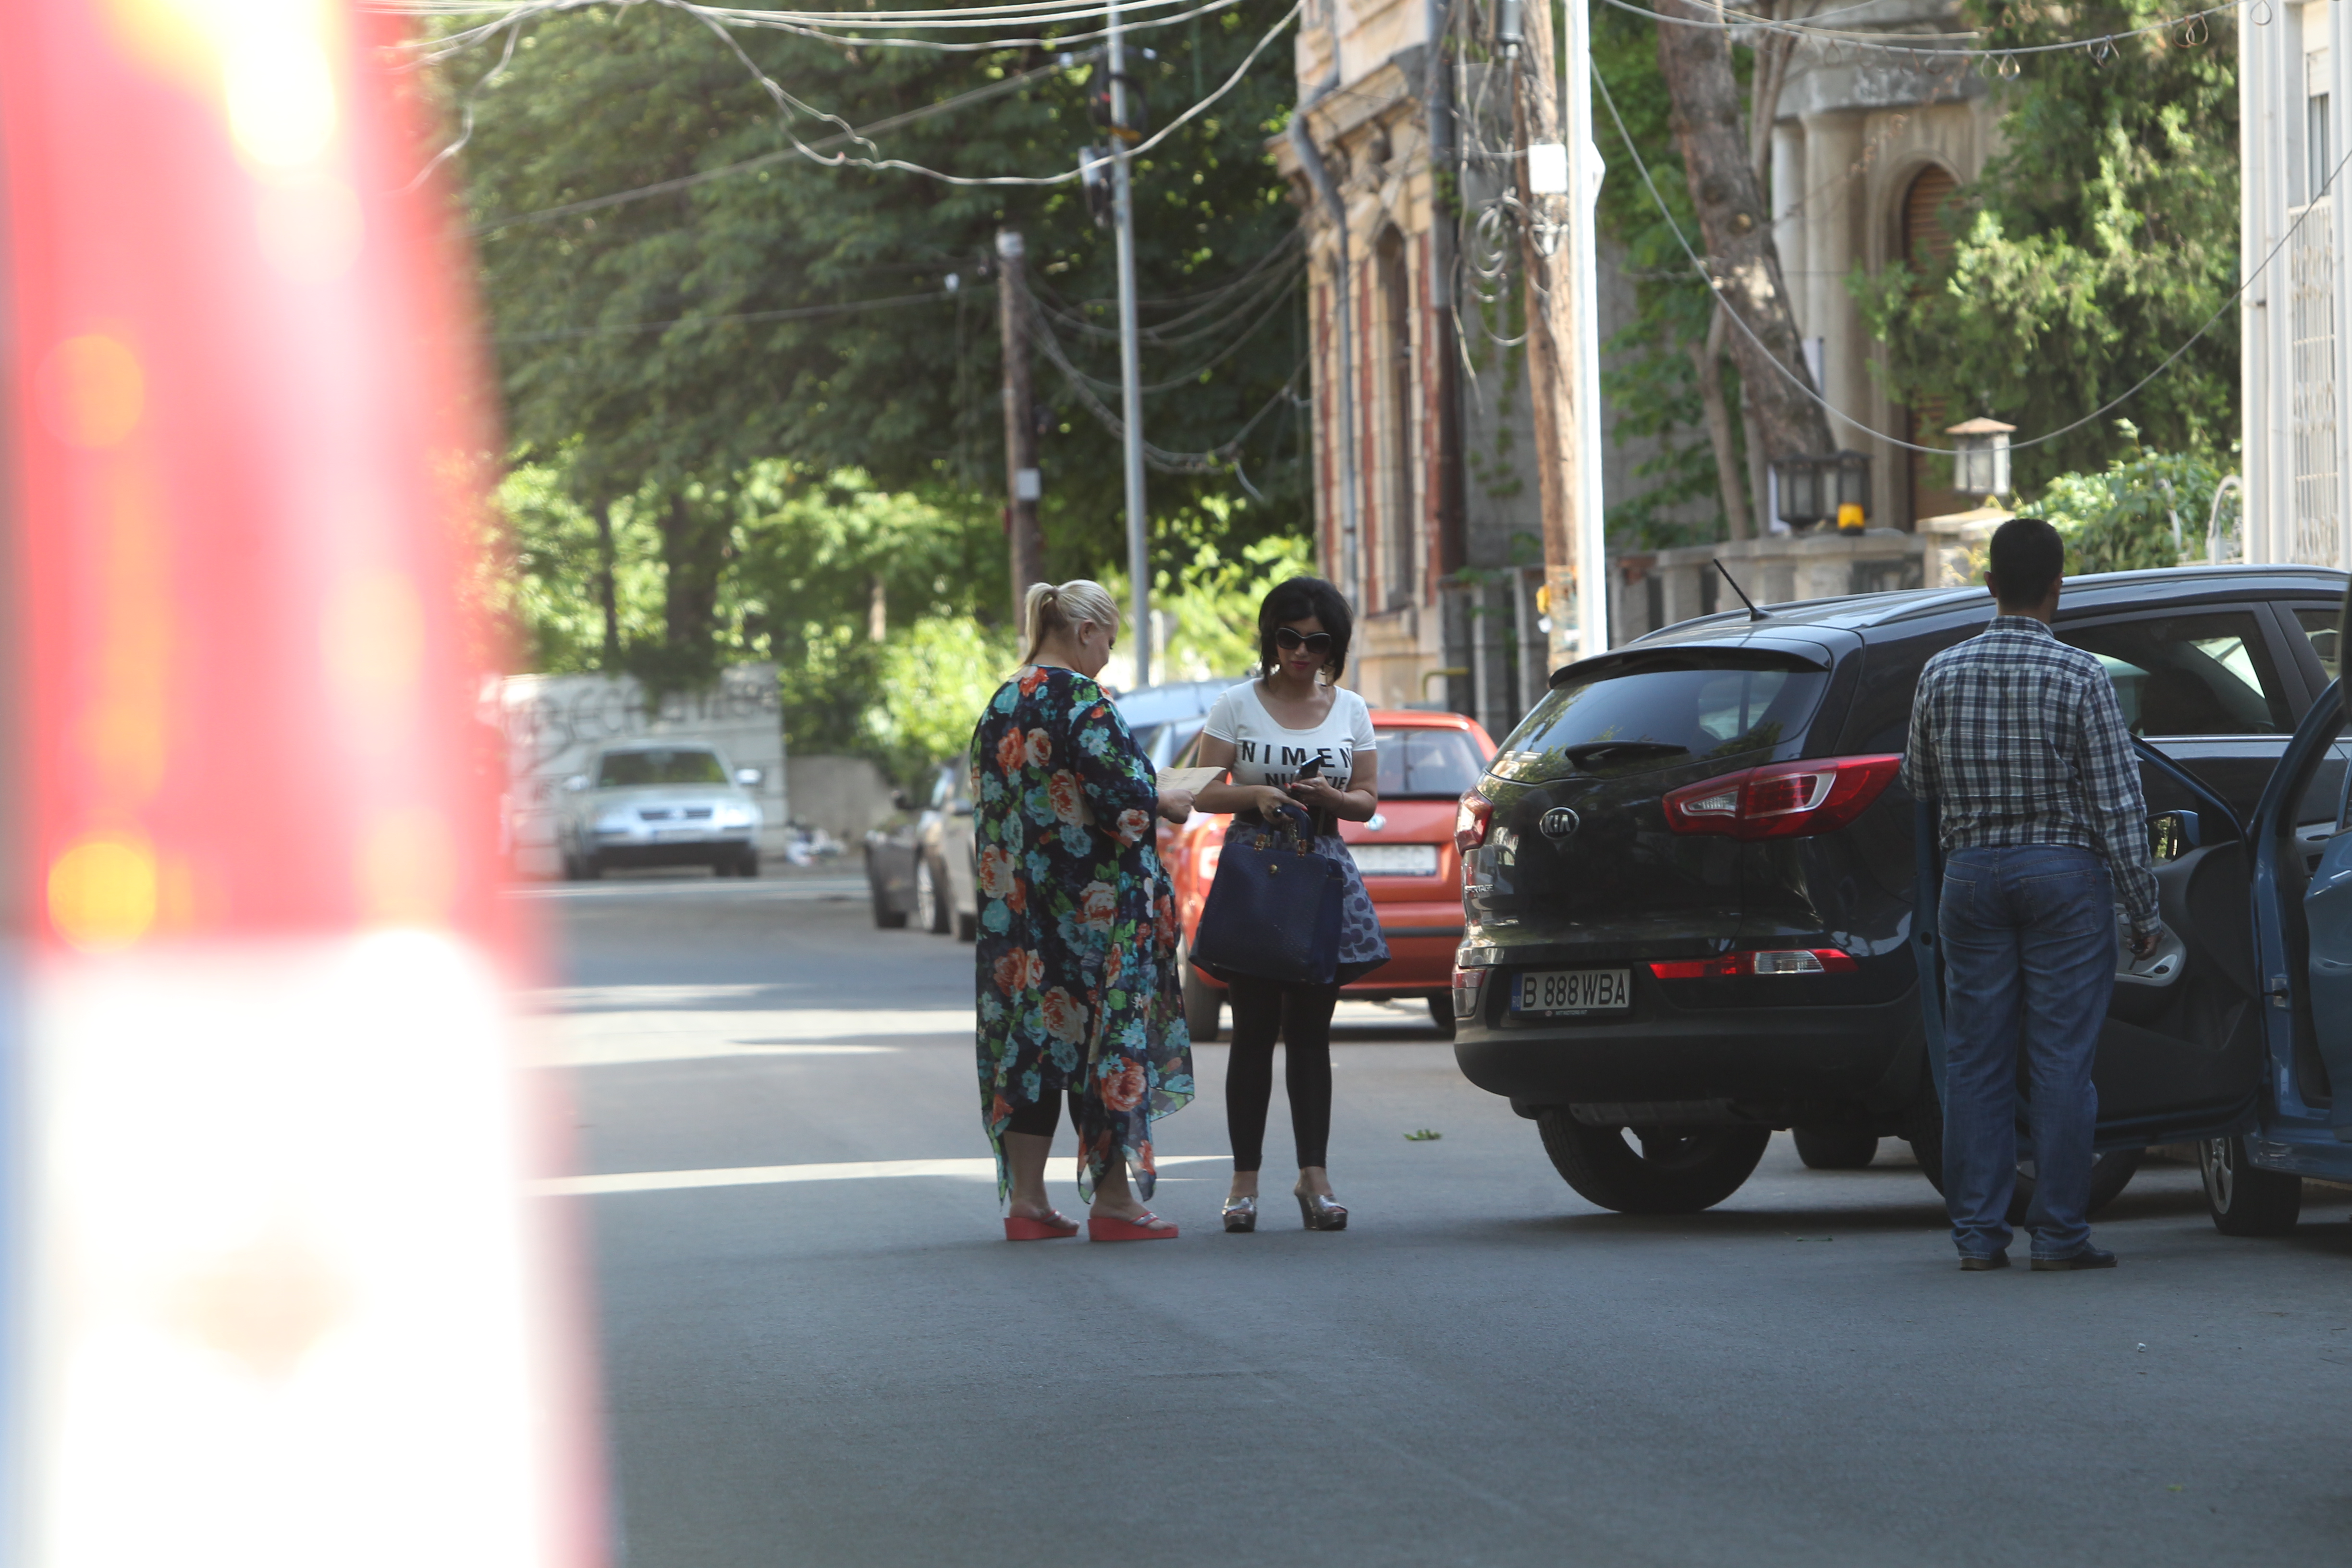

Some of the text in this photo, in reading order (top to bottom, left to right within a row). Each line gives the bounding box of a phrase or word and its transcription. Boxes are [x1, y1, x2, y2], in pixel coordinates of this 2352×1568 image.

[1265, 772, 1294, 786] NU
[1545, 814, 1571, 833] KIA
[1523, 973, 1626, 1008] B 888 WBA
